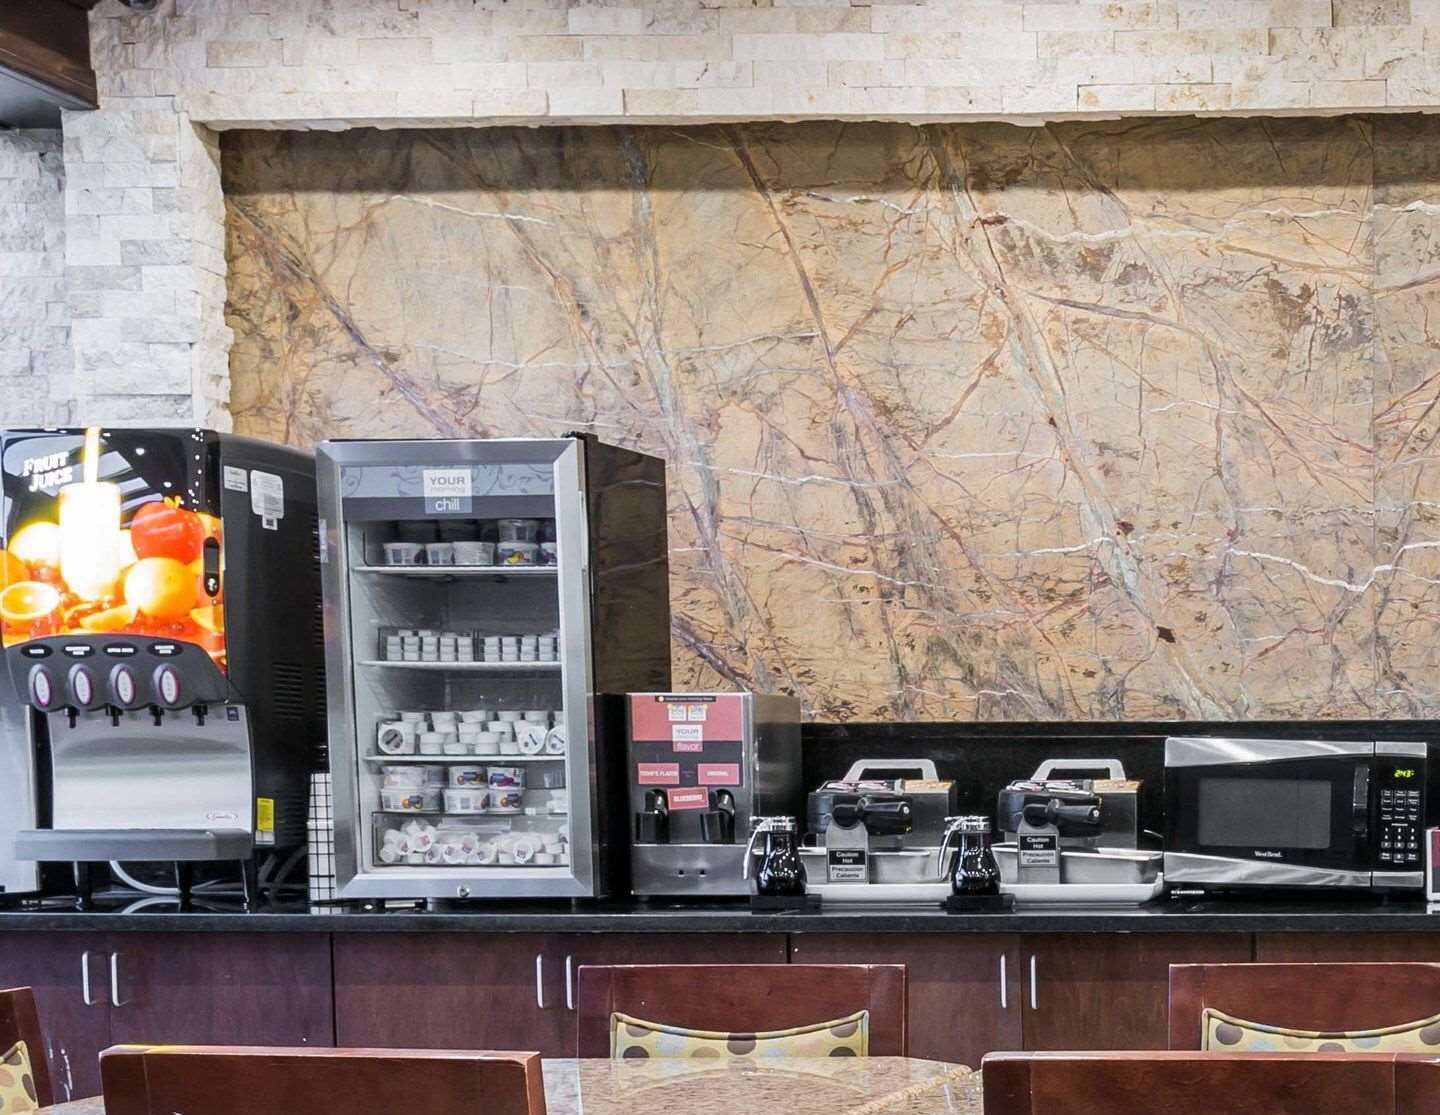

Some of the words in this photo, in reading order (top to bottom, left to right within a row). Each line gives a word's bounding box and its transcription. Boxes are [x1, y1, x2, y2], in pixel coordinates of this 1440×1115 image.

[29, 466, 72, 492] JUICE
[431, 476, 465, 485] YOUR
[435, 498, 460, 511] chill
